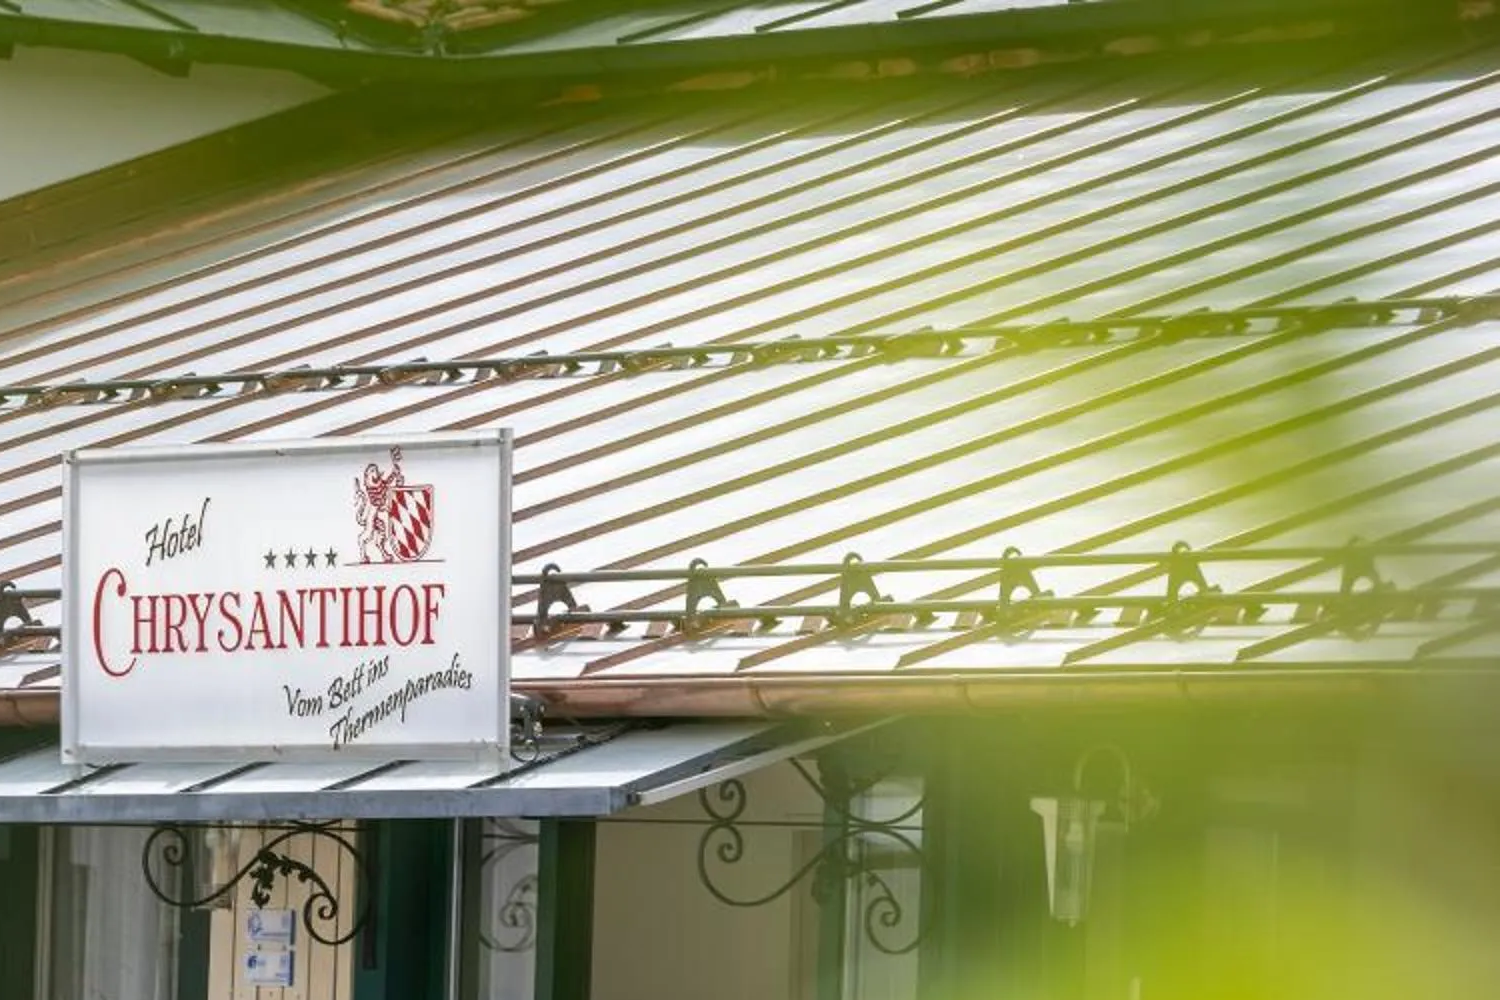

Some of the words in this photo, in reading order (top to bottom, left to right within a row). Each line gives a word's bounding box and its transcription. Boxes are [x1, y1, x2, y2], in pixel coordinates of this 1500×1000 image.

[144, 497, 211, 566] Hotel
[93, 567, 446, 678] CHRYSANTIHOF
[283, 684, 323, 717] Vom
[327, 662, 366, 709] Bett
[366, 655, 390, 687] ins
[329, 652, 473, 750] Thermenparadies
